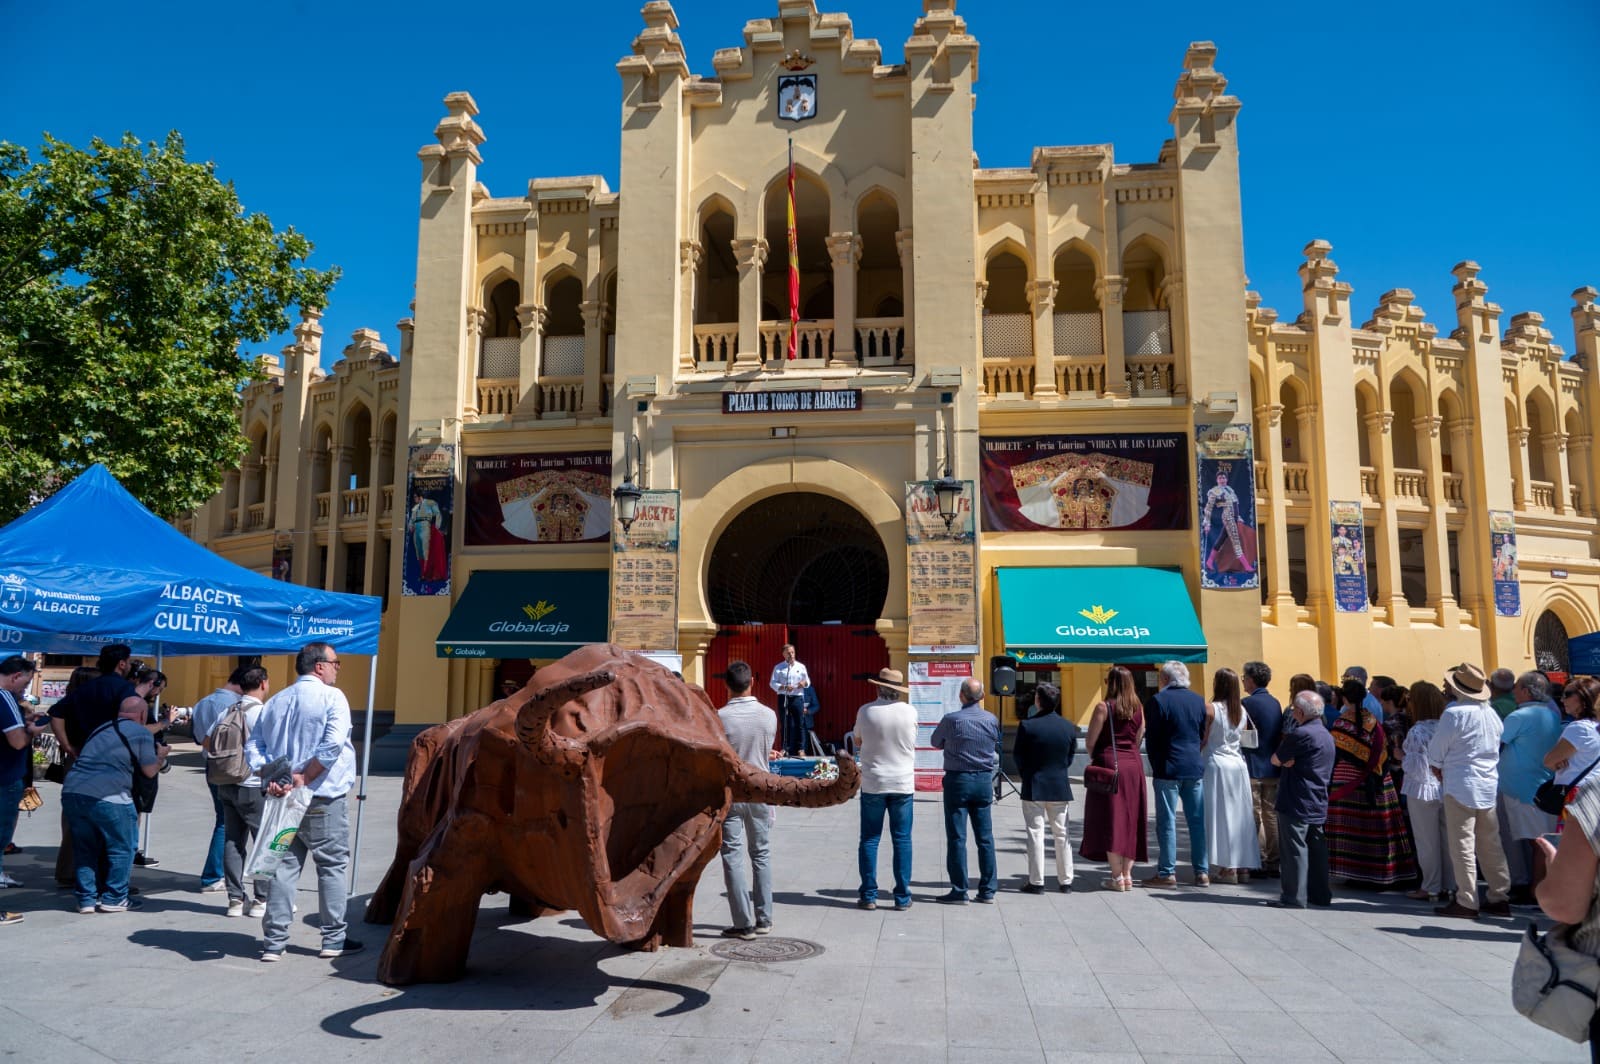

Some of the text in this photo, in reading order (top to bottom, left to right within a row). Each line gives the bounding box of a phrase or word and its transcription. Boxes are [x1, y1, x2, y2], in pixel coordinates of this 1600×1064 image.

[728, 391, 857, 412] PLAZA DE TOROS DE ALBACETE
[986, 441, 1022, 451] ALBACETE
[1036, 440, 1055, 450] Feria
[1058, 440, 1086, 450] Taurina
[1120, 439, 1130, 449] DE
[1132, 438, 1145, 448] LOS
[475, 460, 507, 469] ALBACETE
[520, 459, 537, 468] Feria
[540, 458, 565, 467] Taurina
[912, 496, 970, 513] ALBATE
[34, 588, 101, 602] Ayuntamiento
[160, 583, 244, 608] ALBACETE
[32, 600, 100, 616] ALBACETE
[194, 603, 208, 613] ES
[154, 612, 241, 636] CULTURA
[308, 615, 353, 626] Ayuntamiento
[488, 620, 570, 635] Globalcaja
[307, 625, 354, 636] ALBACETE
[1055, 625, 1150, 639] Globalcaja
[454, 648, 486, 656] Globalcaja
[1028, 652, 1065, 661] Globalcaja
